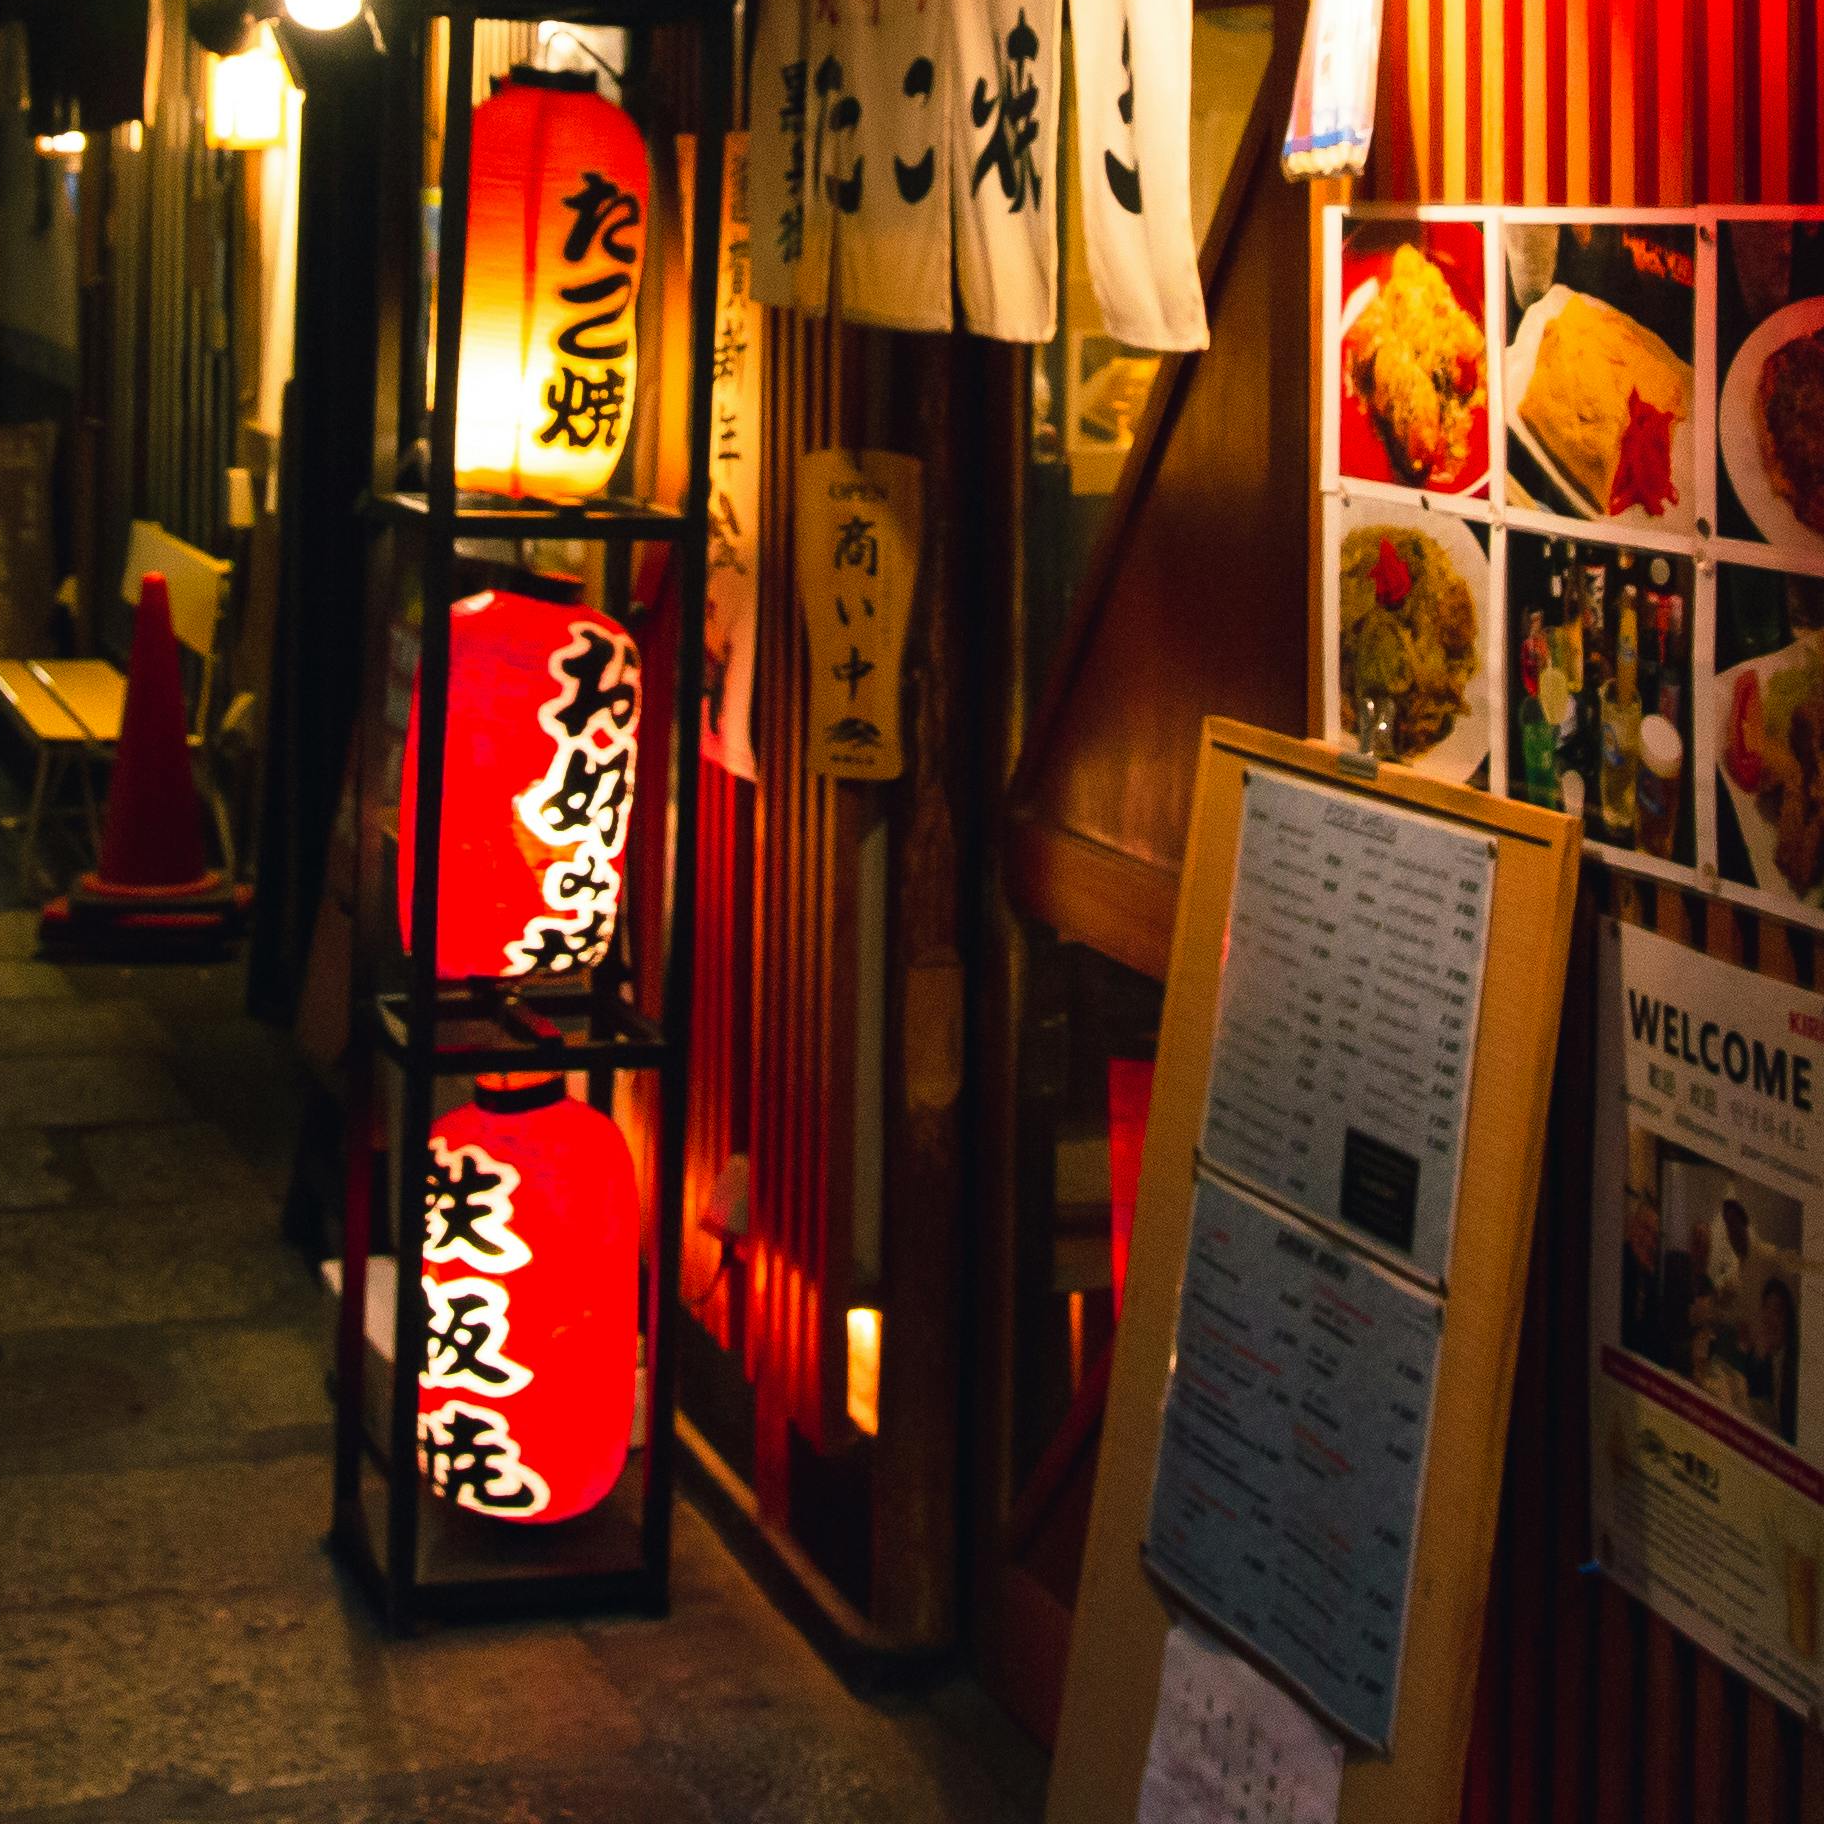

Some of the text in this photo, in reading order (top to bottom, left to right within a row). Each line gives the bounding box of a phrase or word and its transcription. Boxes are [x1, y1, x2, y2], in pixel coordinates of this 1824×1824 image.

[539, 171, 642, 448] たこ焼
[834, 515, 877, 700] 商い中
[1628, 988, 1813, 1113] WELCOME
